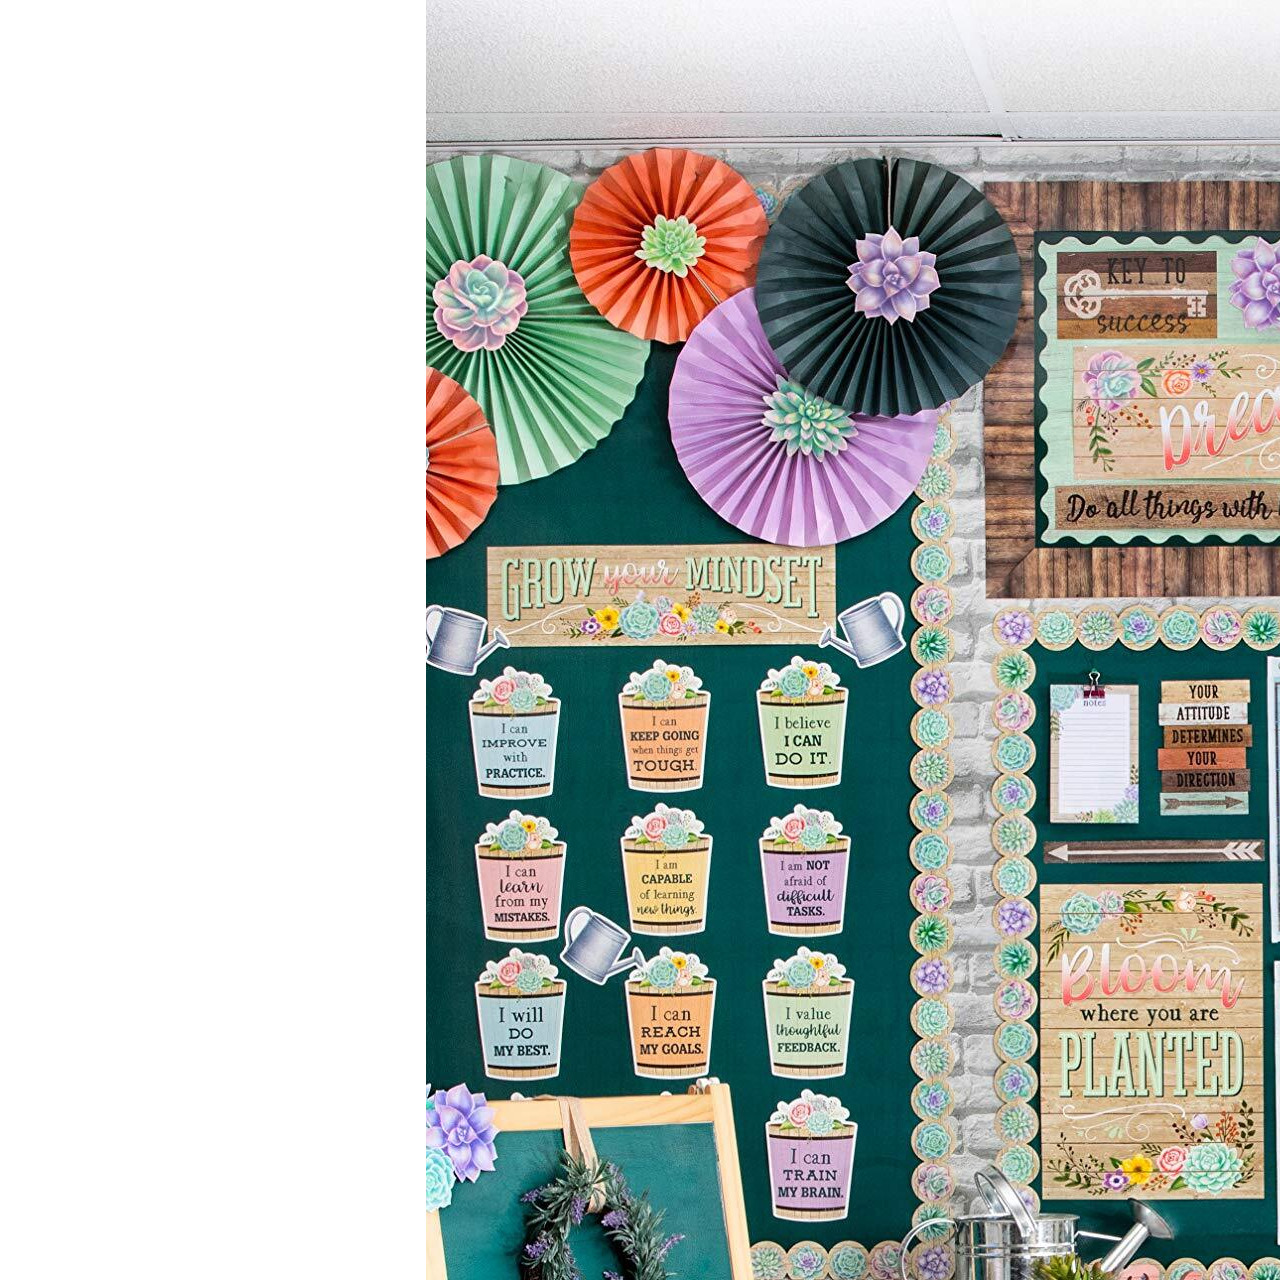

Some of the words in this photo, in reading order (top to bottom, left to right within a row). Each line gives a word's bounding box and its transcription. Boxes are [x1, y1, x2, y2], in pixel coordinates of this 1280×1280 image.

[1107, 257, 1154, 284] KEY
[1163, 257, 1186, 283] TO
[1097, 313, 1191, 334] success
[1067, 494, 1099, 522] Do
[1106, 491, 1139, 519] all
[1144, 491, 1217, 523] things
[1222, 492, 1272, 519] with
[501, 557, 597, 621] GROW
[603, 560, 681, 595] your
[685, 555, 823, 619] MINDSET
[1189, 685, 1219, 698] YOUR
[1176, 706, 1231, 720] ATTITUDE
[502, 723, 506, 734] I
[509, 726, 528, 734] can
[660, 719, 677, 727] can
[775, 716, 779, 729] I
[785, 716, 831, 729] believe
[630, 731, 659, 741] KEEP
[662, 731, 700, 741] GOING
[784, 735, 790, 747] I
[793, 735, 822, 747] CAN
[1172, 729, 1244, 744] DETERMINES
[482, 739, 547, 748] IMPROVE
[503, 752, 528, 762] with
[632, 745, 654, 754] when
[656, 745, 682, 757] things
[685, 746, 699, 757] get
[775, 752, 803, 765] DO
[810, 752, 832, 764] IT.
[1187, 751, 1217, 765] YOUR
[634, 760, 697, 772] TOUGH.
[486, 768, 546, 778] PRACTICE.
[1176, 772, 1236, 787] DIRECTION
[506, 865, 510, 877] I
[515, 868, 536, 877] can
[787, 863, 803, 871] am
[806, 860, 830, 870] NOT
[500, 879, 543, 893] learn
[784, 876, 813, 886] afraid
[816, 875, 827, 886] of
[495, 895, 525, 907] from
[530, 898, 548, 910] my
[777, 889, 835, 905] difficult
[494, 912, 550, 922] MISTAKES.
[787, 906, 825, 916] TASKS.
[1062, 943, 1245, 1008] Bloom
[651, 1005, 657, 1021] I
[663, 1010, 691, 1021] can
[1080, 1004, 1139, 1021] where
[1147, 1008, 1181, 1026] you
[1189, 1008, 1219, 1021] are
[641, 1026, 701, 1038] REACH
[640, 1044, 659, 1055] MY
[662, 1043, 704, 1054] GOALS.
[1058, 1030, 1244, 1098] PLANTED
[791, 1148, 797, 1164] I
[803, 1153, 831, 1164] can
[783, 1170, 838, 1181] TRAIN
[778, 1187, 798, 1198] MY
[801, 1187, 844, 1198] BRAIN.
